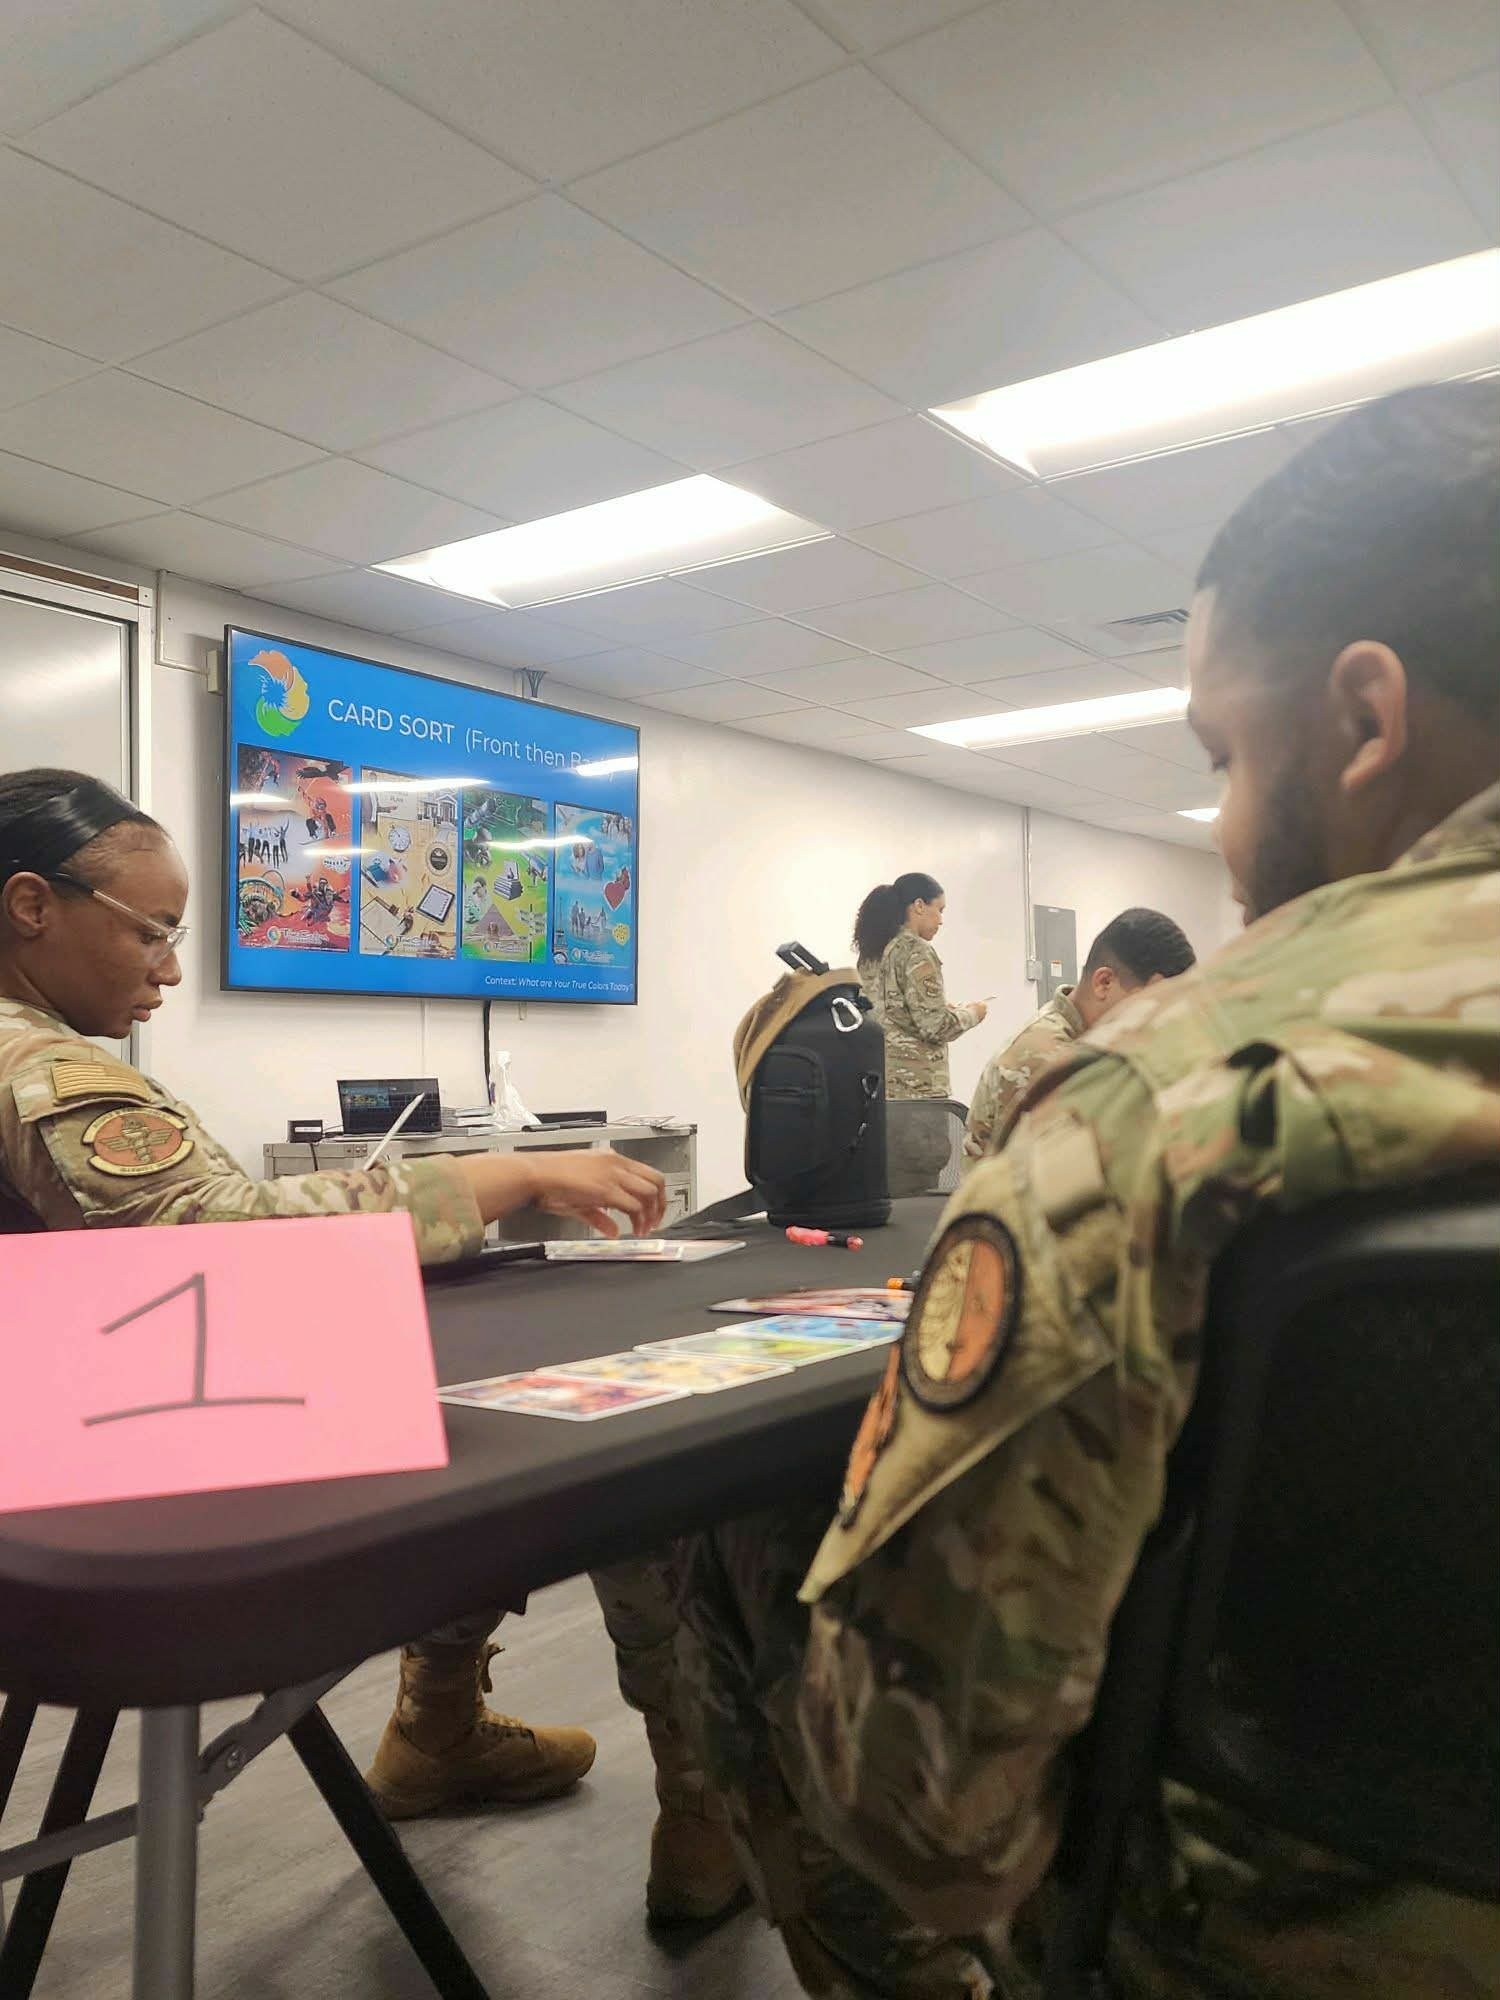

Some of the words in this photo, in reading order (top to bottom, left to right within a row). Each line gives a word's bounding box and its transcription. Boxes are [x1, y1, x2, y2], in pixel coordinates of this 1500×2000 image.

[328, 699, 393, 731] CARD
[399, 714, 455, 744] SORT
[465, 727, 520, 759] (Front
[525, 741, 565, 767] then
[485, 975, 516, 986] Context:
[518, 977, 539, 987] What
[540, 980, 552, 988] are
[554, 979, 571, 989] Your
[572, 980, 587, 990] True
[588, 981, 609, 991] Colors
[82, 1272, 306, 1427] 1
